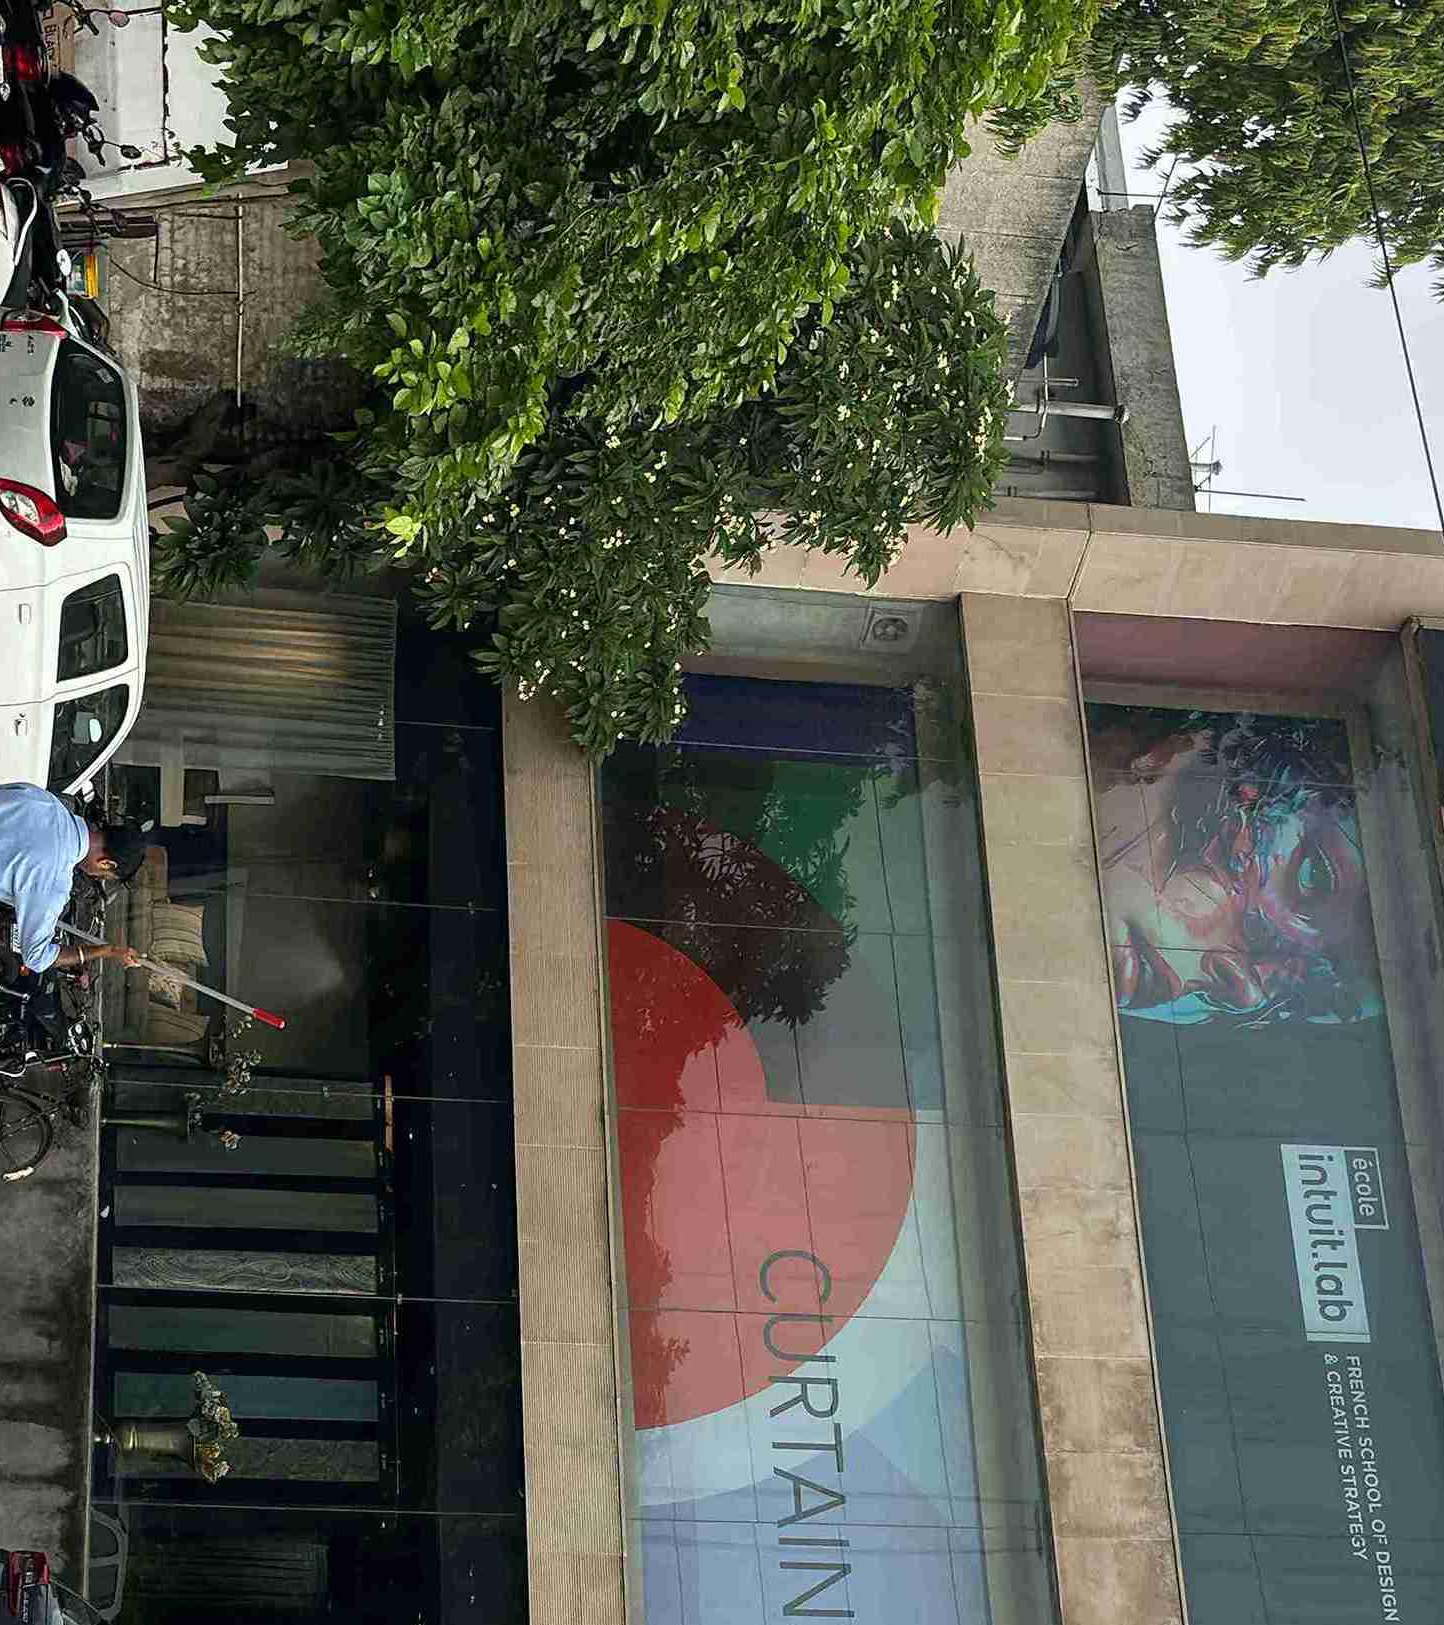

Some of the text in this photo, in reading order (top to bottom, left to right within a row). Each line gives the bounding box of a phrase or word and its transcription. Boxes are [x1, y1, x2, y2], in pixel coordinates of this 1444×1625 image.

[1298, 1154, 1354, 1322] intuit.lab
[1352, 1157, 1379, 1217] école
[1324, 1353, 1368, 1561] & CREATIVE STRATEGY
[1346, 1355, 1400, 1623] FRENCH SCHOOL OF DESIGN
